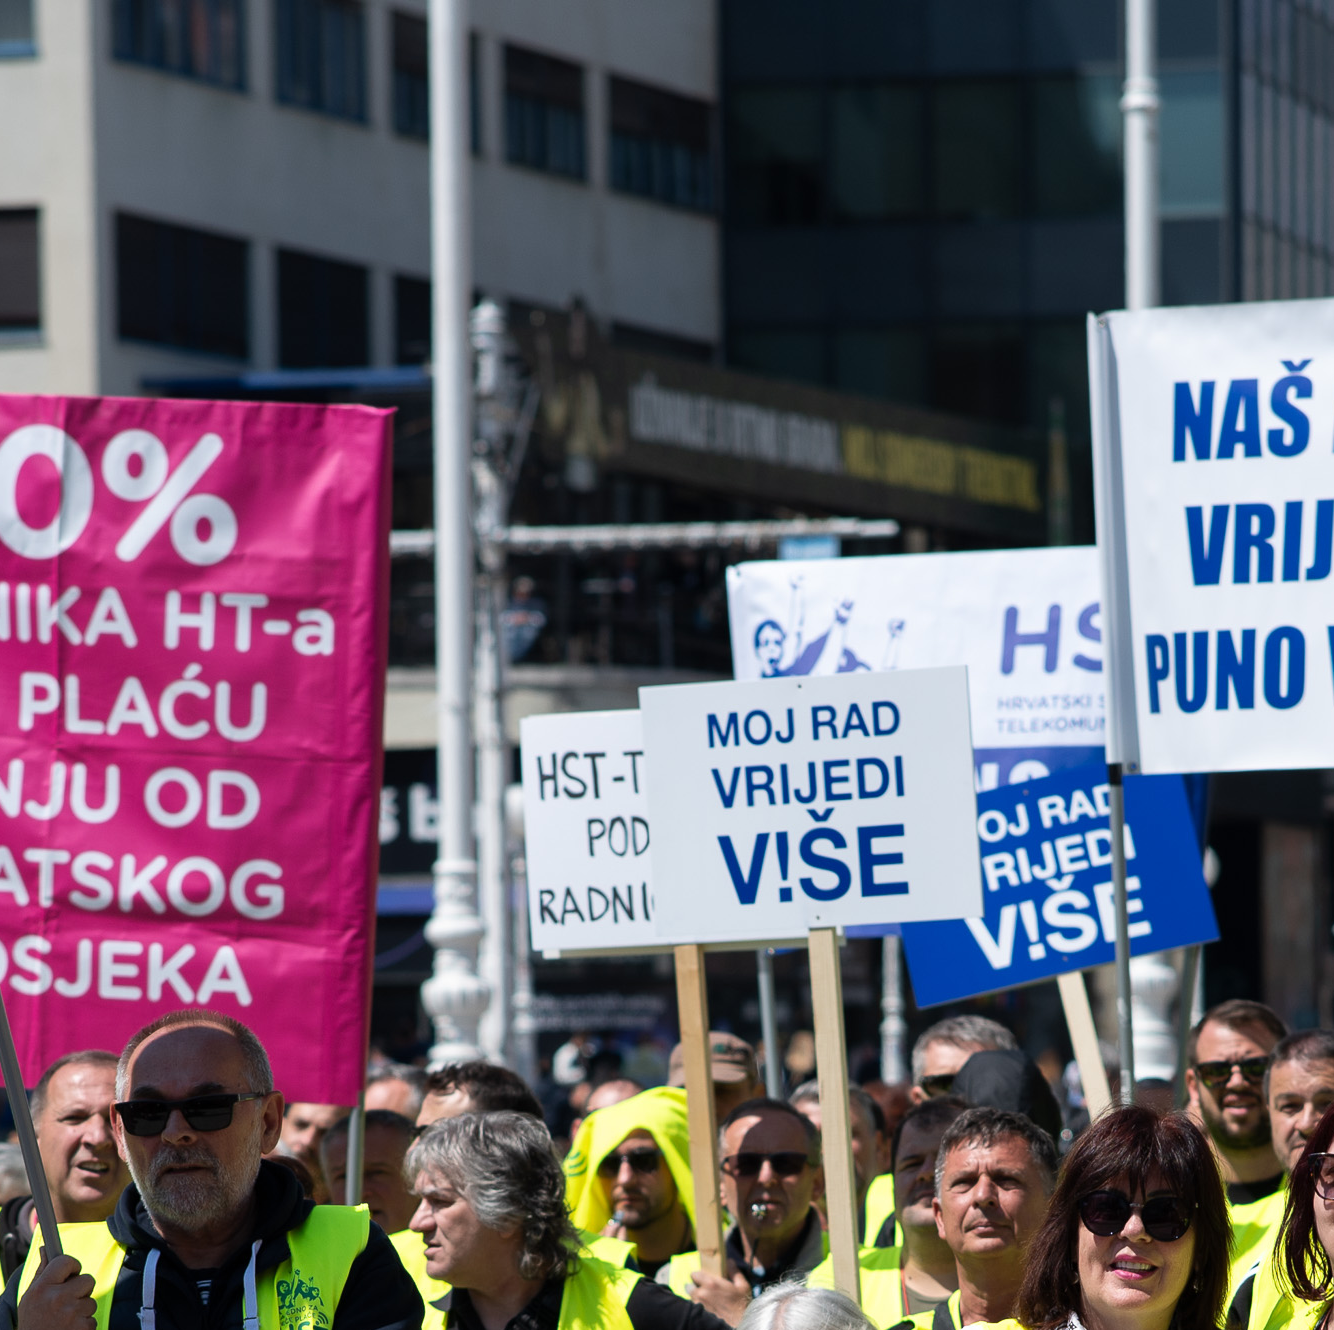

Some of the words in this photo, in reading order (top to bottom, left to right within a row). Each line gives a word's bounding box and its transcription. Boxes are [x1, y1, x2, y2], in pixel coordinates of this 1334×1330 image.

[1173, 359, 1314, 462] NAŠ
[164, 590, 336, 656] HT-a
[1145, 625, 1306, 714] PUNO
[18, 663, 268, 742] PLAĆU
[706, 706, 796, 749] MOJ
[811, 700, 901, 742] RAD
[996, 716, 1106, 734] TELEKOMU
[143, 767, 262, 830] OD
[537, 751, 644, 801] HST-T
[710, 755, 906, 809] VRIJEDI
[587, 815, 651, 857] POD
[976, 803, 1030, 843] OJ
[717, 806, 910, 906] V!ŠE
[981, 823, 1137, 892] RIJEDI
[539, 881, 654, 926] RADNI
[963, 873, 1153, 971] V!ŠE
